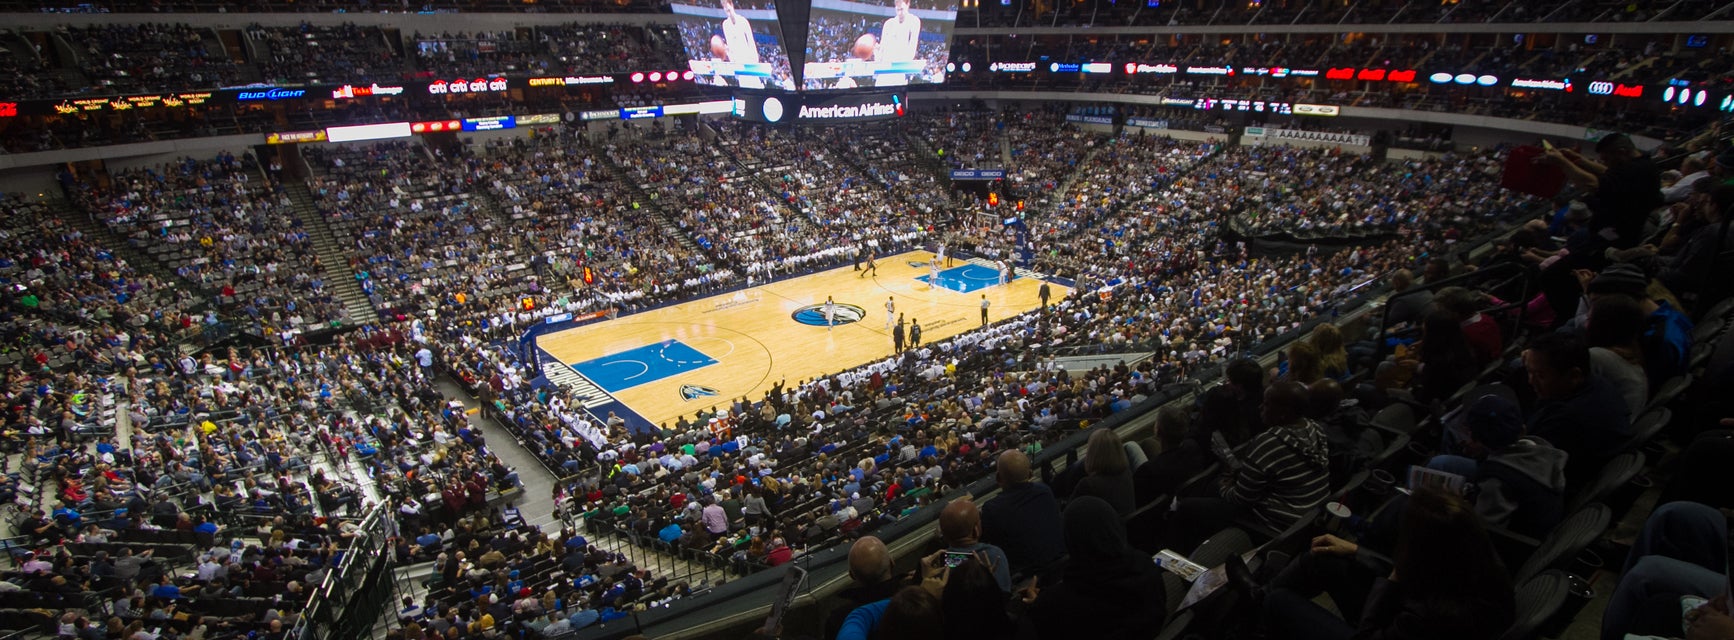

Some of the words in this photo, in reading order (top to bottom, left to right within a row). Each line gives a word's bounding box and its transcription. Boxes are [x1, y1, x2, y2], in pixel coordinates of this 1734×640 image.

[529, 78, 555, 86] CENTURY
[799, 104, 859, 118] American
[859, 103, 895, 117] Airlines
